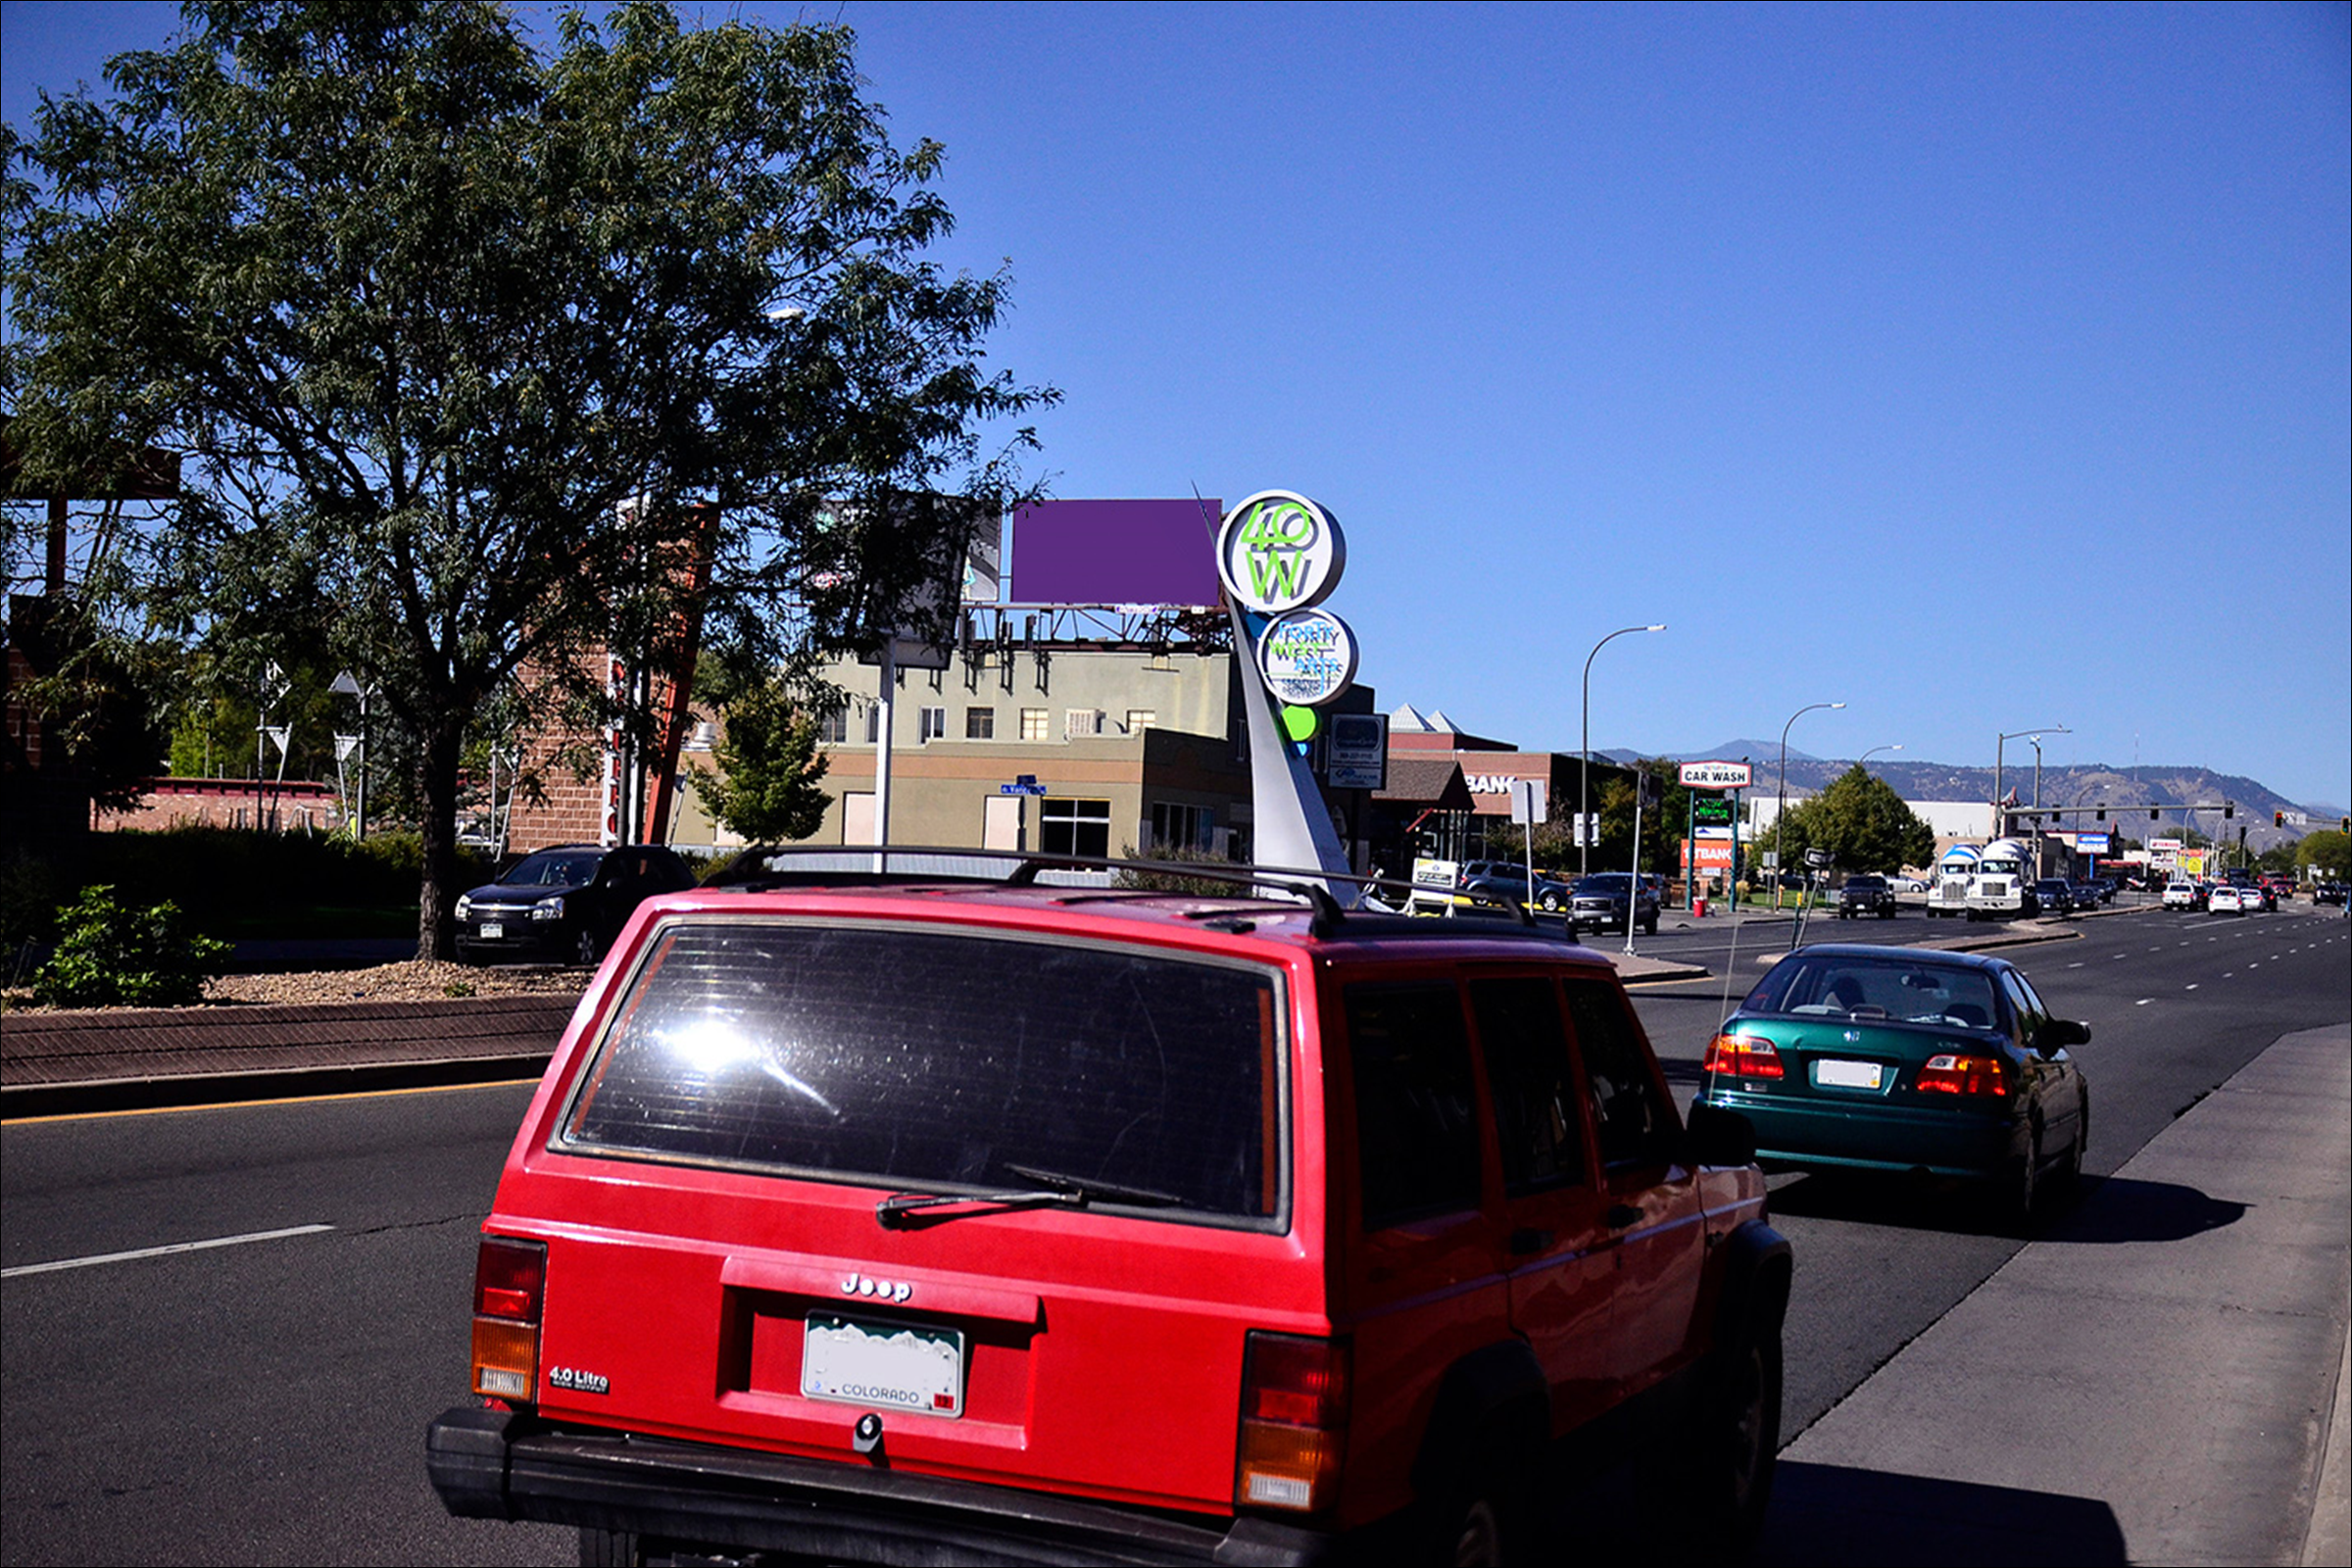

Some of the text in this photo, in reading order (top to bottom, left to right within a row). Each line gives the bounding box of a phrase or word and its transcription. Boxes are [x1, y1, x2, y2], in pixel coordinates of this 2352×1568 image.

[1241, 502, 1311, 551] 40
[1246, 550, 1303, 599] W
[1279, 621, 1334, 639] FORTY
[1268, 639, 1330, 657] WEST
[1685, 771, 1745, 782] CAR WASH
[1684, 847, 1732, 859] 1TBANK
[841, 1274, 911, 1303] Jeep
[550, 1366, 572, 1382] 4.0
[842, 1384, 919, 1403] COLORADO
